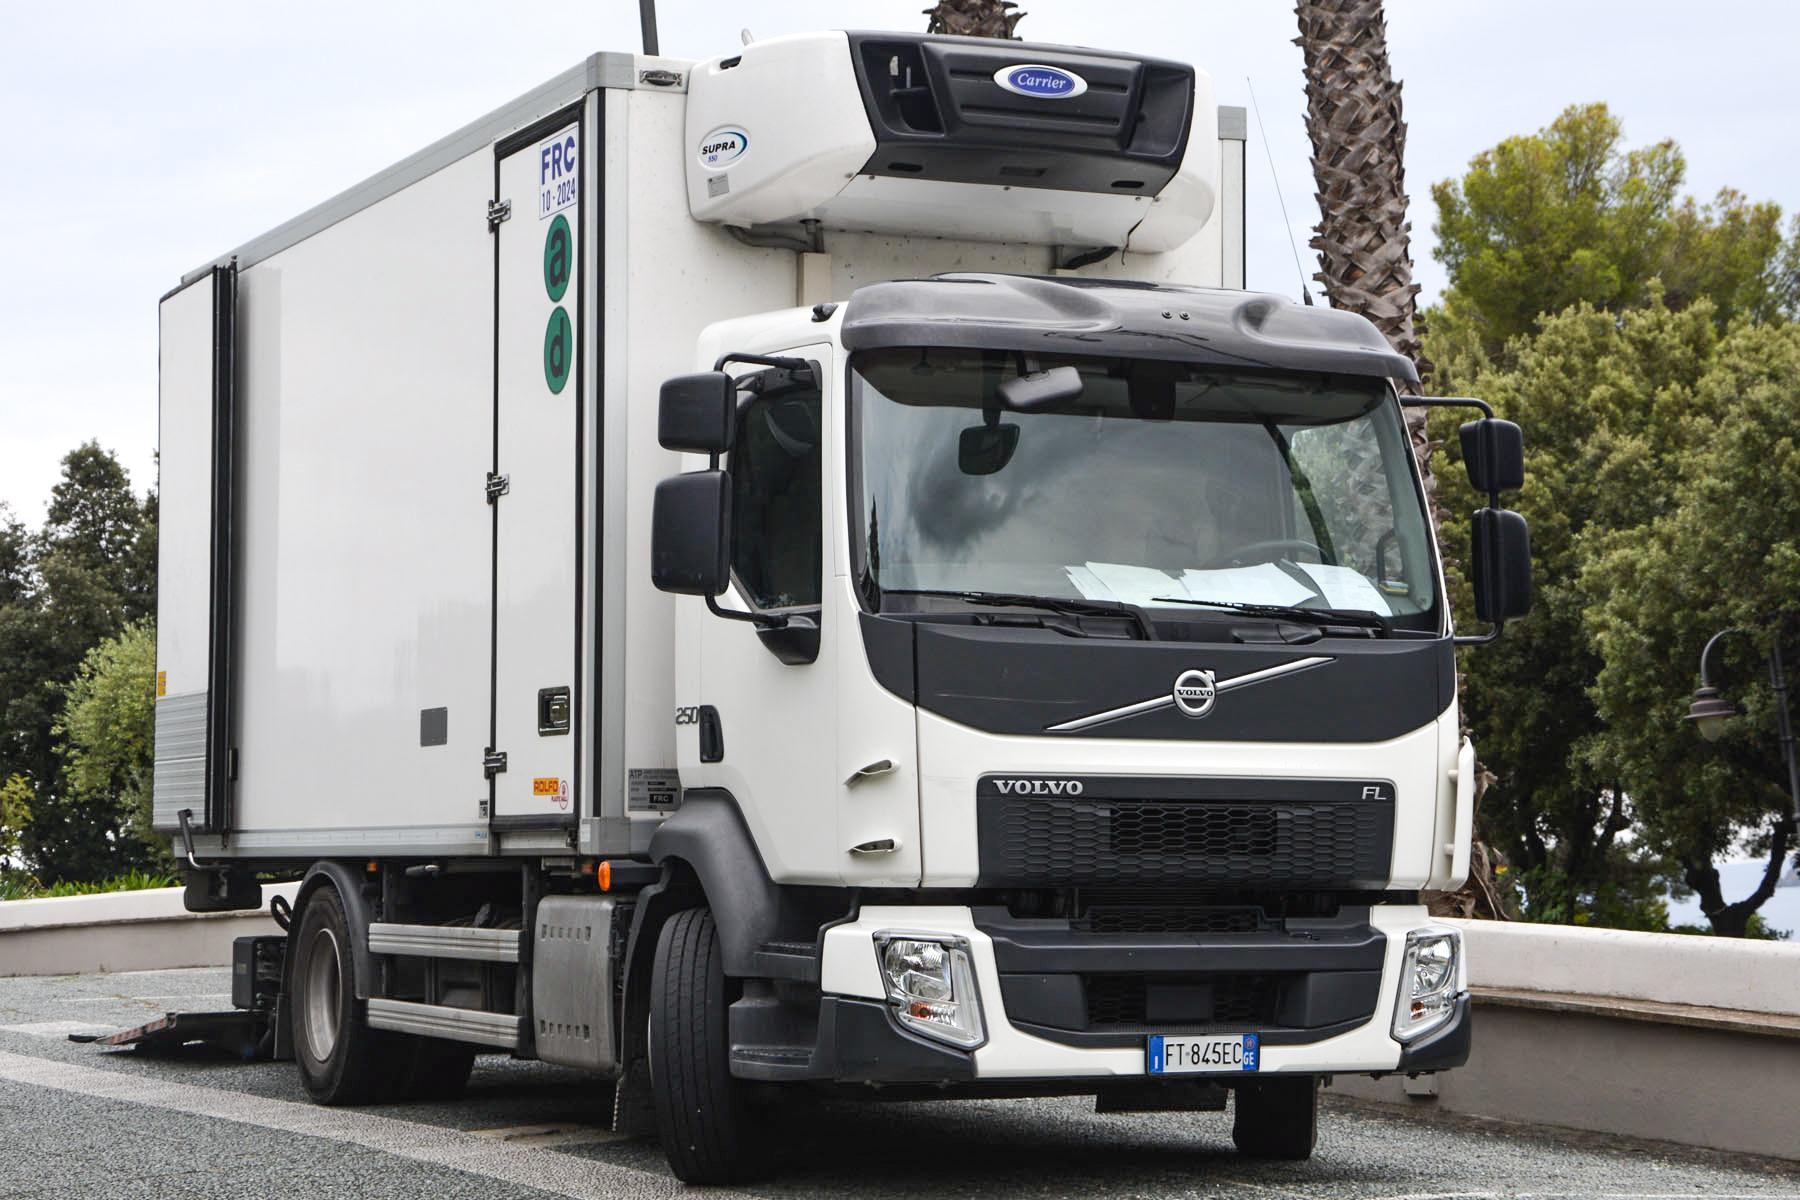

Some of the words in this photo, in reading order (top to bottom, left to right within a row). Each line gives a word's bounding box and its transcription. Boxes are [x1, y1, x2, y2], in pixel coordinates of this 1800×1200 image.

[1018, 73, 1066, 89] Carrier
[702, 140, 736, 156] SUPRA
[541, 136, 575, 185] FRC
[542, 189, 551, 213] 10
[557, 177, 576, 206] 2024
[550, 228, 566, 287] a
[550, 317, 565, 378] d
[1177, 689, 1214, 697] VOLVO
[676, 706, 699, 725] 250
[533, 780, 559, 793] ROLFO
[992, 780, 1084, 796] VOLVO
[1361, 786, 1388, 800] FL
[1243, 1052, 1255, 1065] GE
